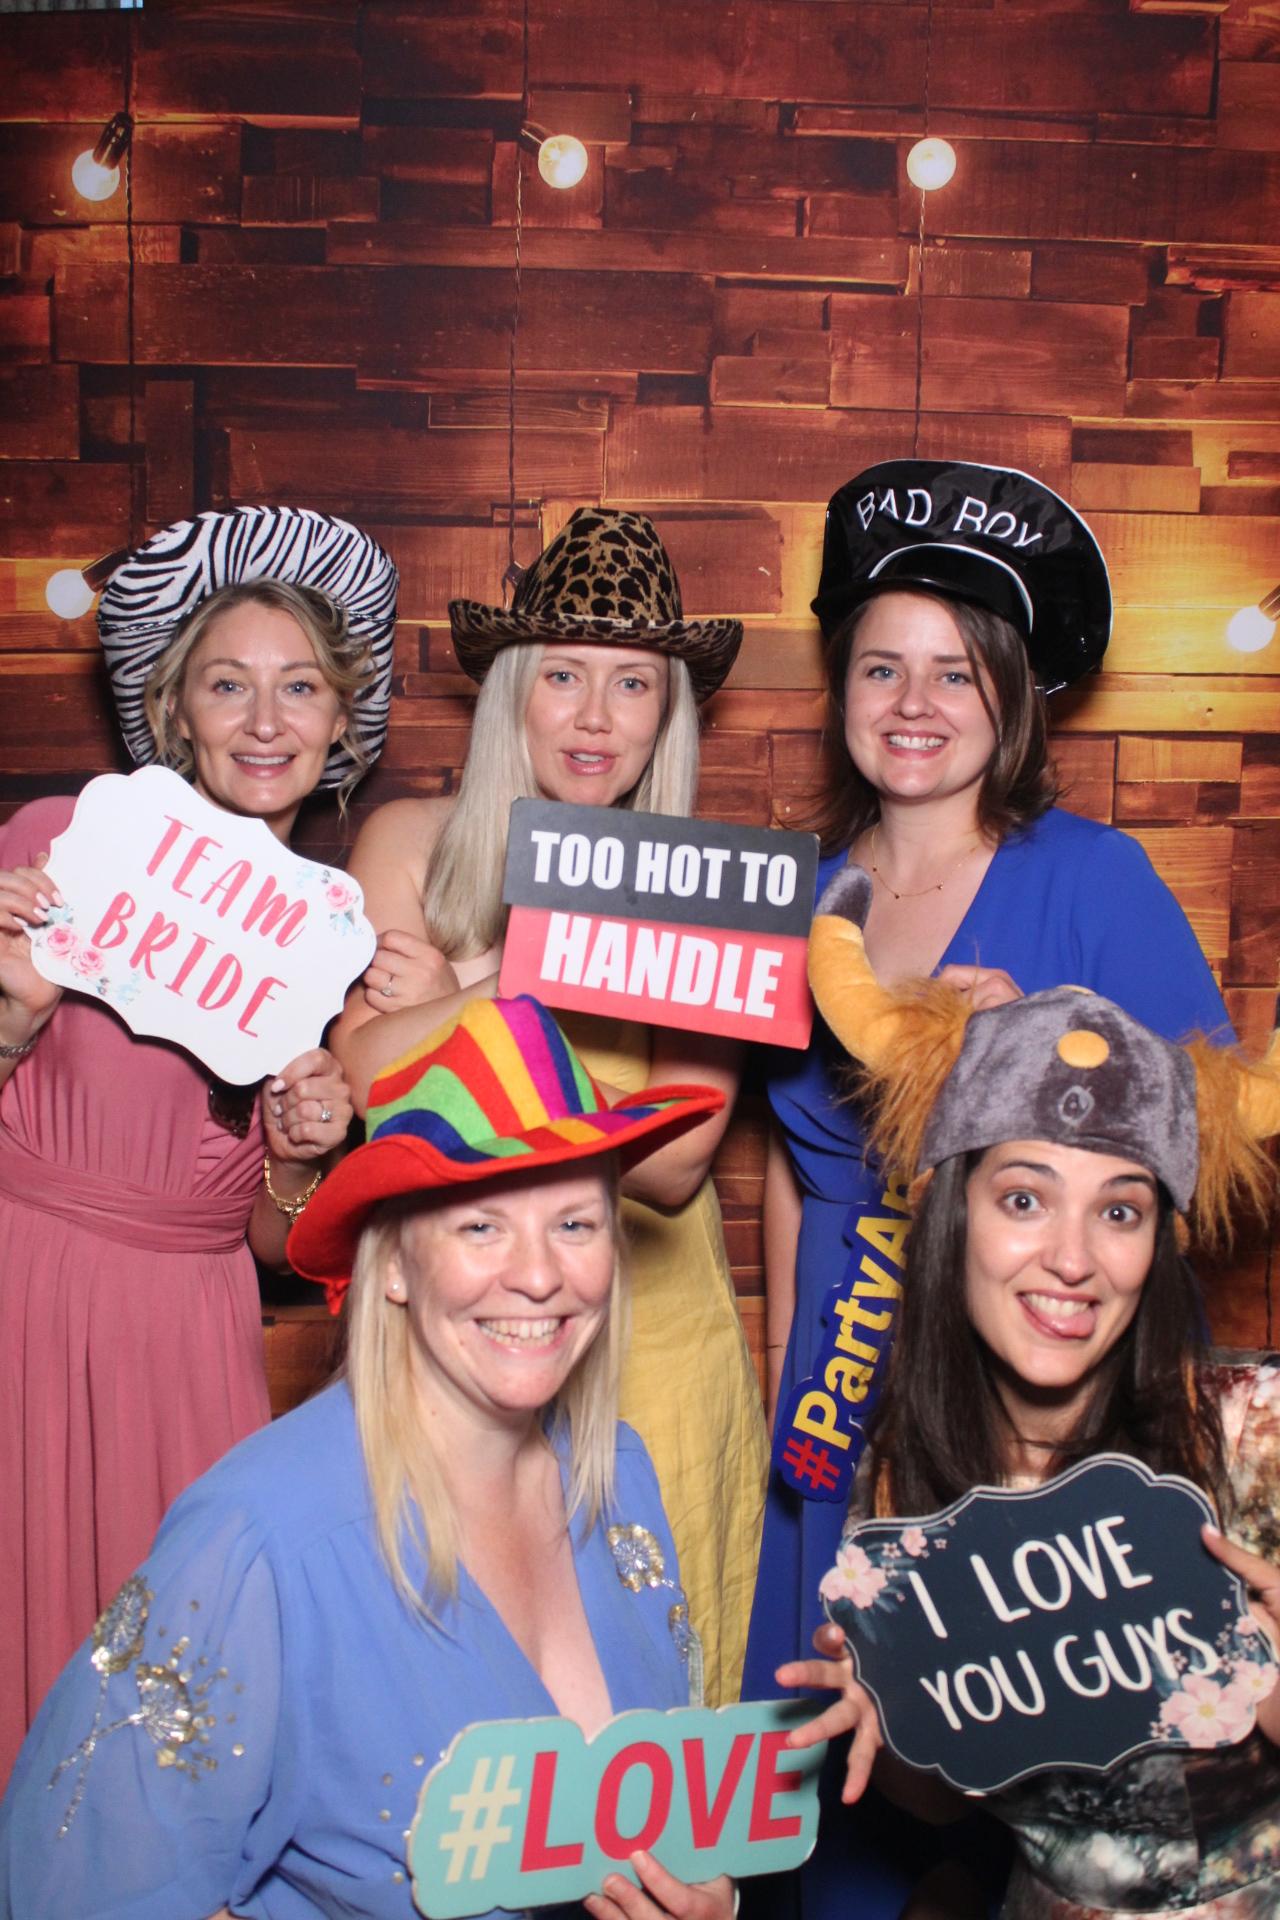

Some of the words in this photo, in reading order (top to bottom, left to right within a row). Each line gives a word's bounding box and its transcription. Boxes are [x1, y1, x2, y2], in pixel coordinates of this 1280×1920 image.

[855, 488, 932, 531] BAD
[146, 814, 309, 948] TEAM
[530, 830, 625, 890] TOO
[634, 840, 731, 900] HOT
[740, 850, 798, 907] TO
[90, 891, 289, 1039] BRIDE
[539, 911, 784, 1019] HANDLE
[908, 1570, 948, 1639] I
[970, 1515, 1153, 1623] LOVE
[919, 1650, 1046, 1731] YOU
[1053, 1608, 1219, 1698] GUYS
[438, 1729, 812, 1885] #LOVE
